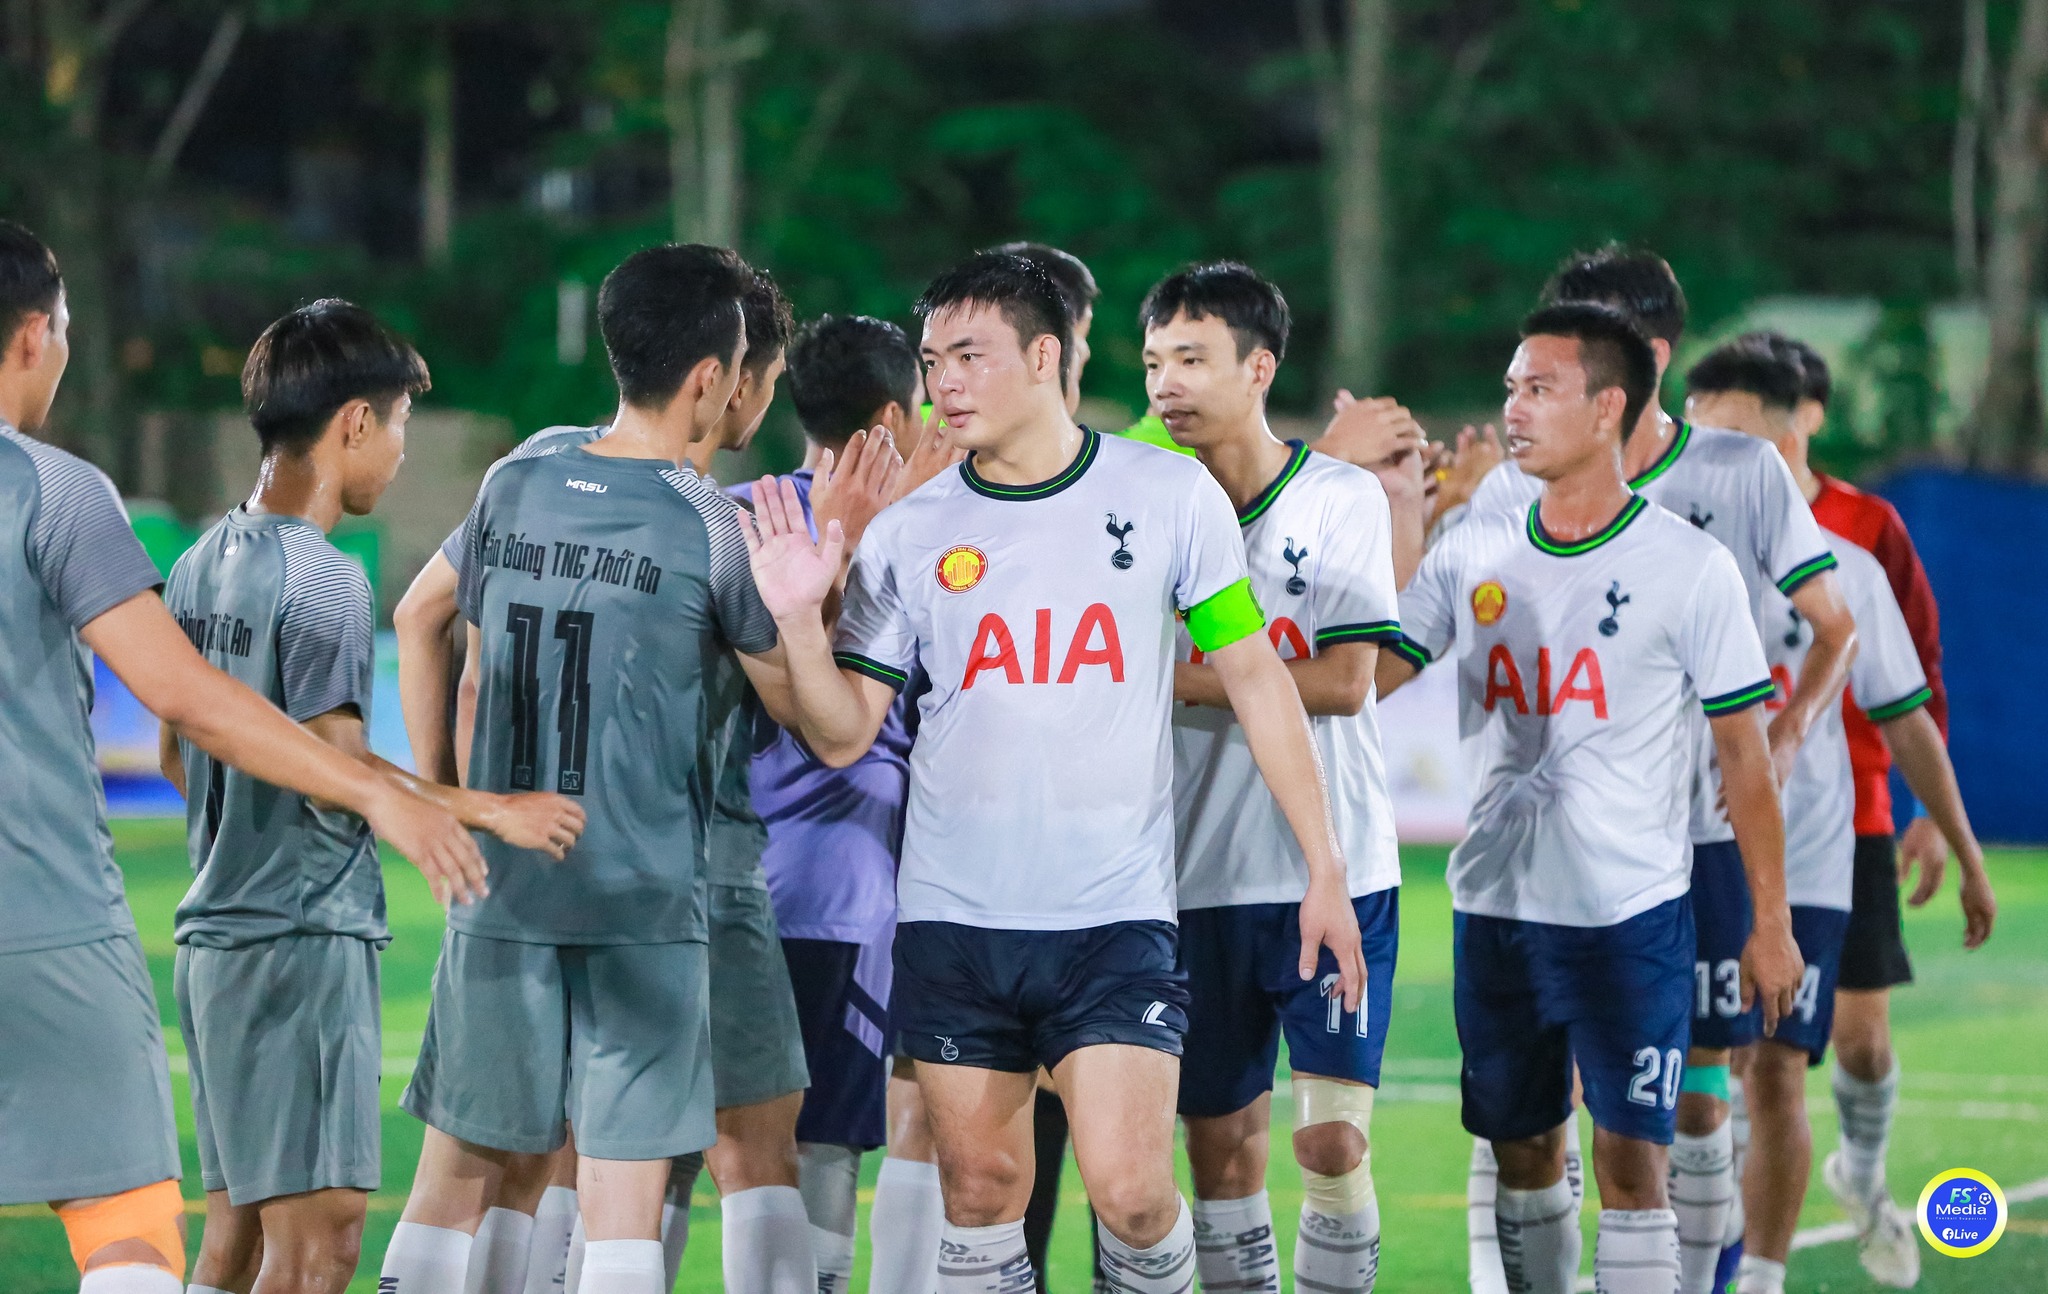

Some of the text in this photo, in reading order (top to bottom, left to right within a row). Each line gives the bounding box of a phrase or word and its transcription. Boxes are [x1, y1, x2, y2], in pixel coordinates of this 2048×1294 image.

[502, 532, 546, 581] Bóng
[551, 541, 590, 580] TNG
[633, 555, 662, 596] An
[229, 617, 253, 658] An
[961, 602, 1125, 691] AIA
[505, 602, 595, 796] 11
[1483, 643, 1609, 720] AIA
[1319, 972, 1369, 1039] 11
[1694, 958, 1742, 1019] 13
[1627, 1045, 1683, 1110] 20
